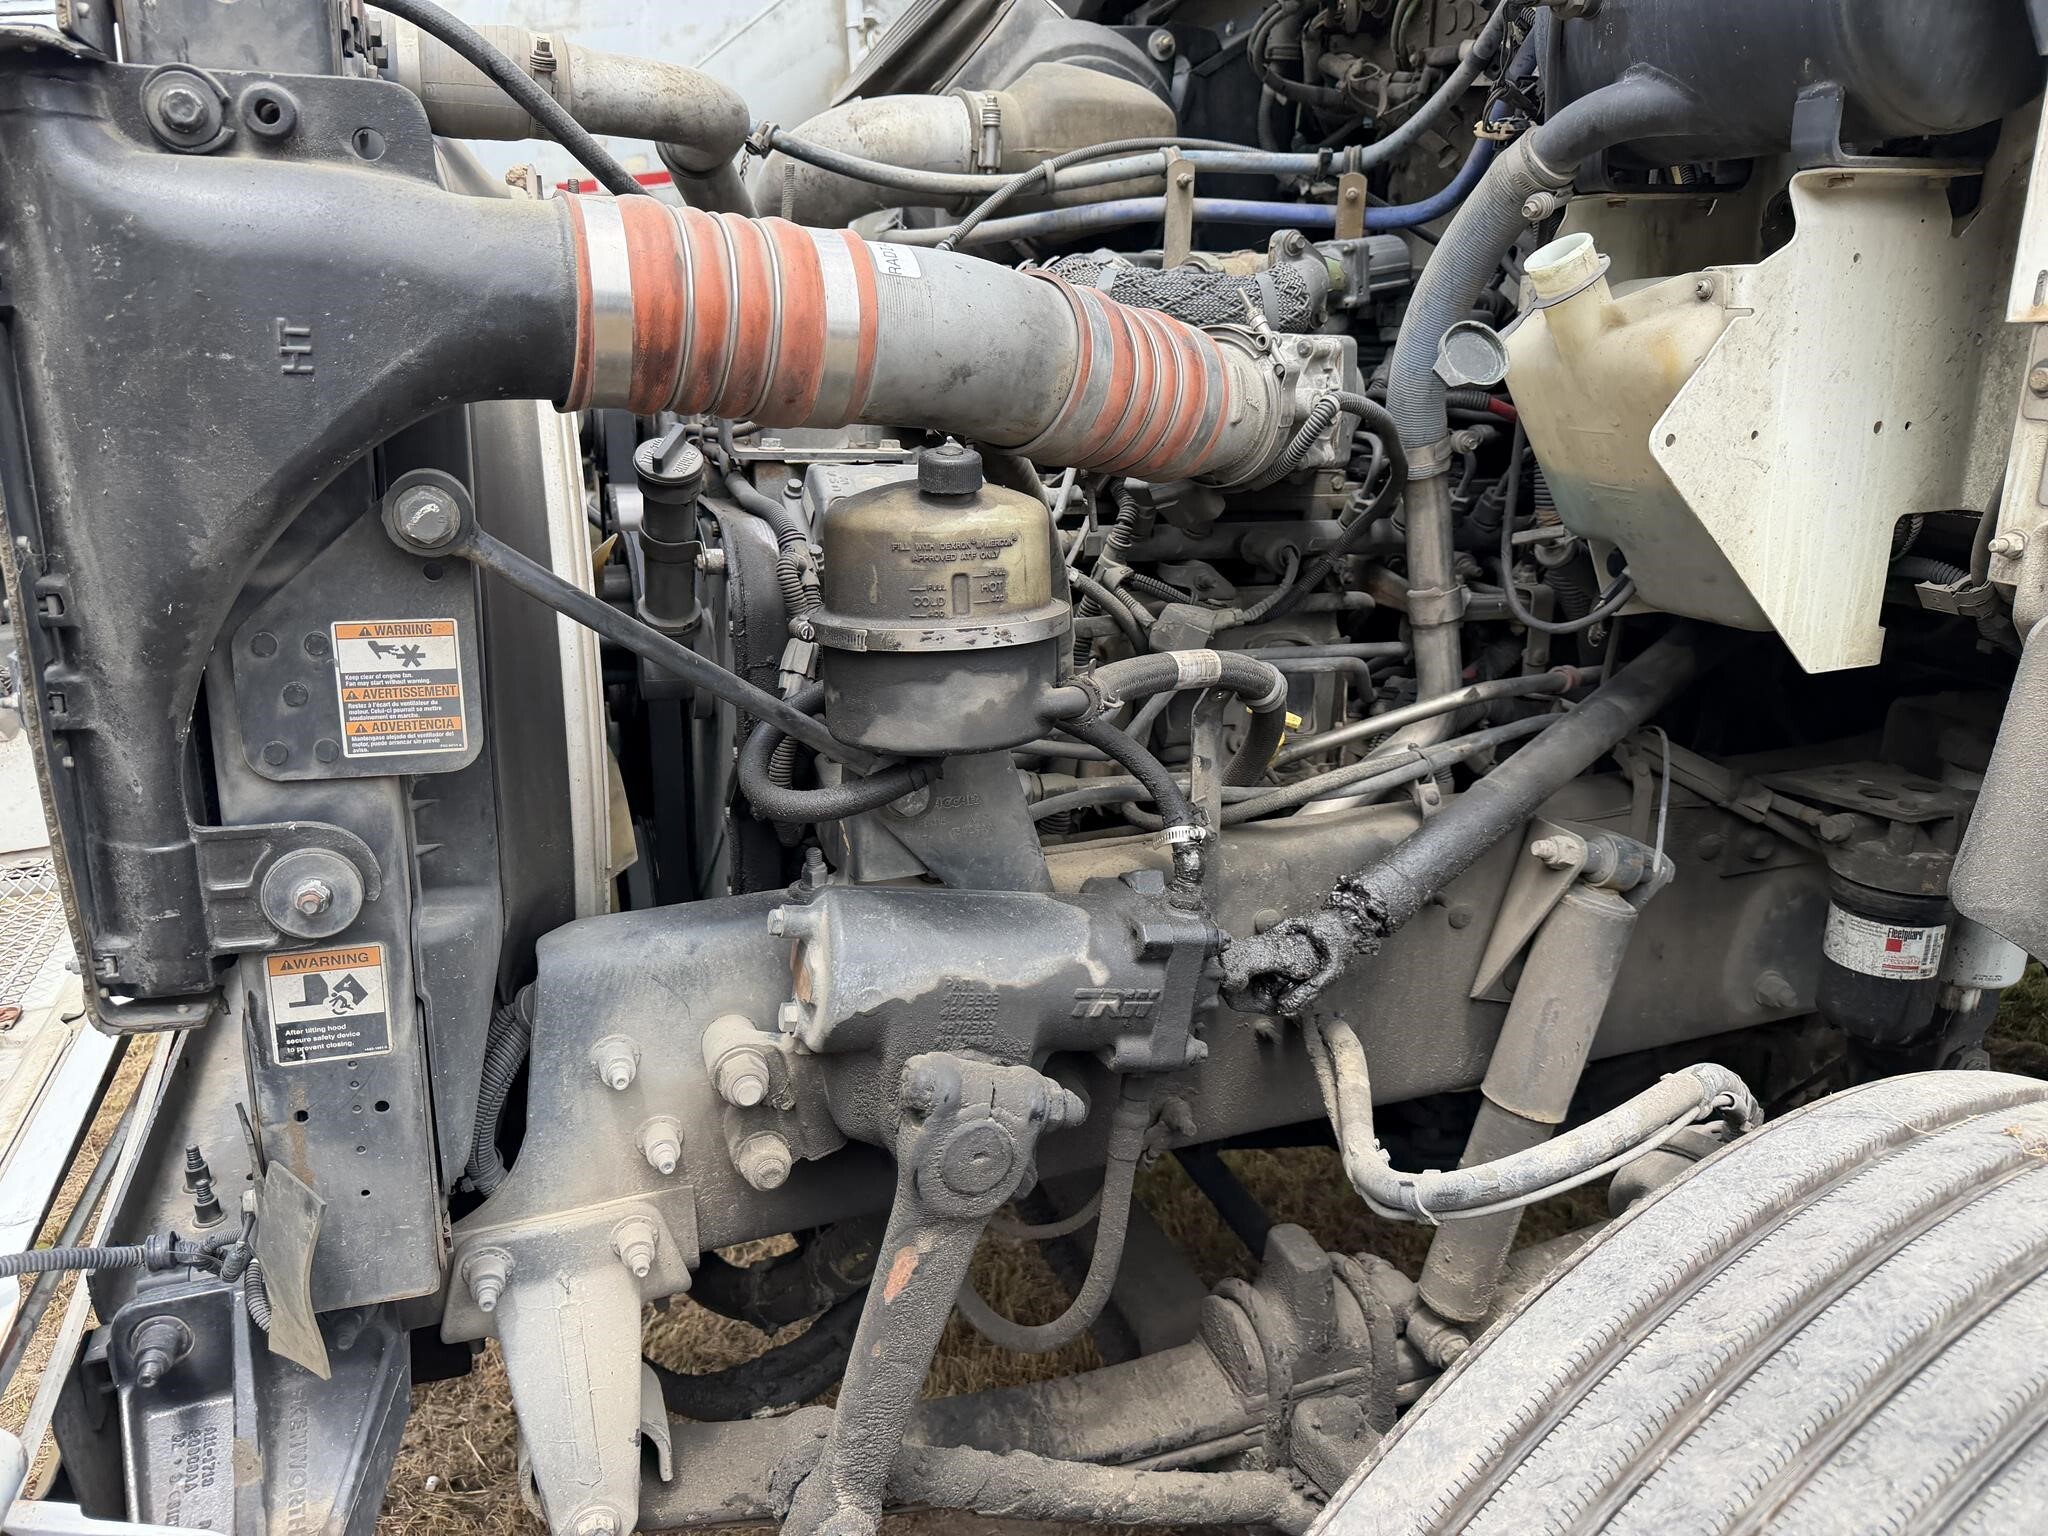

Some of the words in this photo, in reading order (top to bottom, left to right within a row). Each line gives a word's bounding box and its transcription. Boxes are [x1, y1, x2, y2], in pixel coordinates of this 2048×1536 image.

[879, 245, 902, 275] RADI
[911, 553, 957, 563] APPROVED
[980, 550, 1001, 560] ONLY
[981, 581, 1004, 594] HOT
[912, 595, 946, 607] COLD
[374, 623, 433, 636] WARNING
[345, 674, 360, 682] Keep
[382, 673, 402, 681] engine
[407, 677, 431, 686] warning.
[362, 685, 457, 700] AVERTISSEMENT
[371, 719, 455, 733] ADVERTENCIA
[293, 952, 369, 970] WARNING
[285, 1028, 304, 1037] After
[305, 1025, 326, 1035] tilting
[327, 1023, 347, 1032] hood
[286, 1036, 311, 1045] secure
[313, 1033, 335, 1043] safety
[337, 1031, 360, 1040] device
[296, 1043, 325, 1054] prevent
[326, 1040, 355, 1049] closing.
